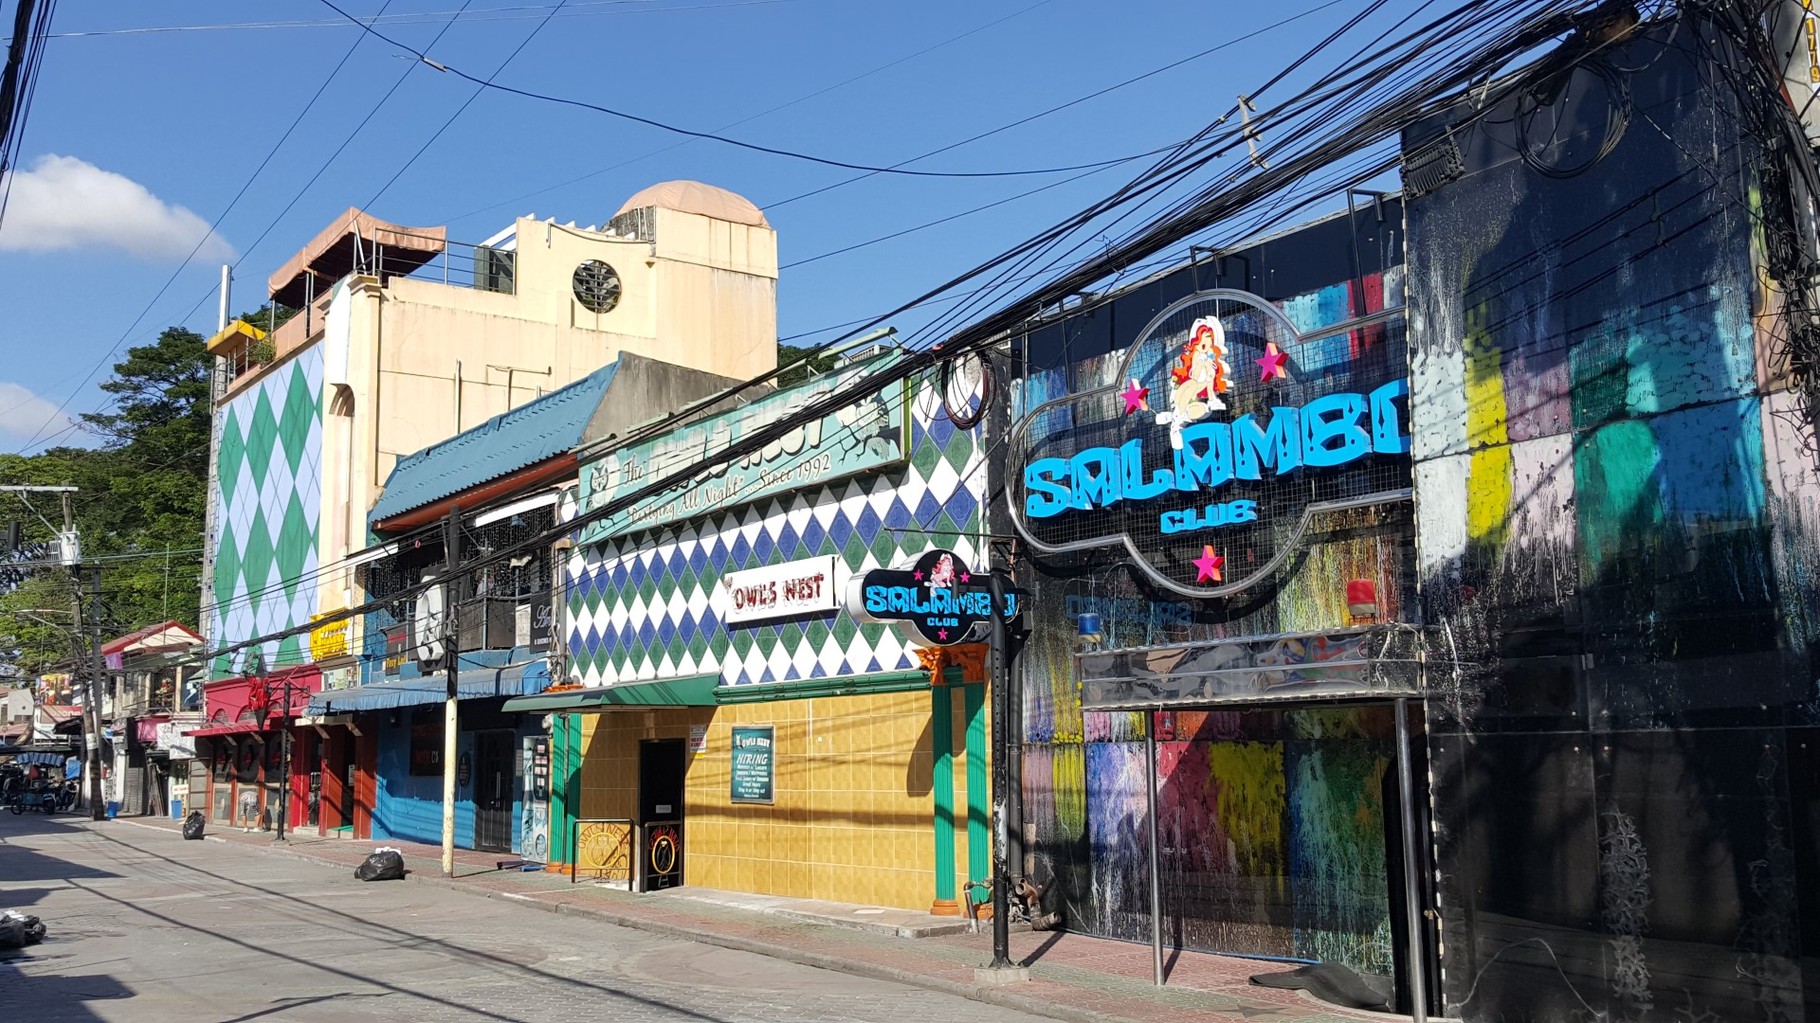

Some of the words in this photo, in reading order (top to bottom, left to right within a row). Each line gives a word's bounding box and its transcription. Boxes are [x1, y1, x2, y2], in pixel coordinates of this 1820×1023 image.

[622, 453, 646, 486] The
[679, 490, 701, 515] All
[797, 453, 832, 483] 1992
[1160, 499, 1257, 535] CLUB
[784, 571, 825, 602] NEST
[927, 617, 958, 627] CLUB
[736, 753, 768, 765] HIRING
